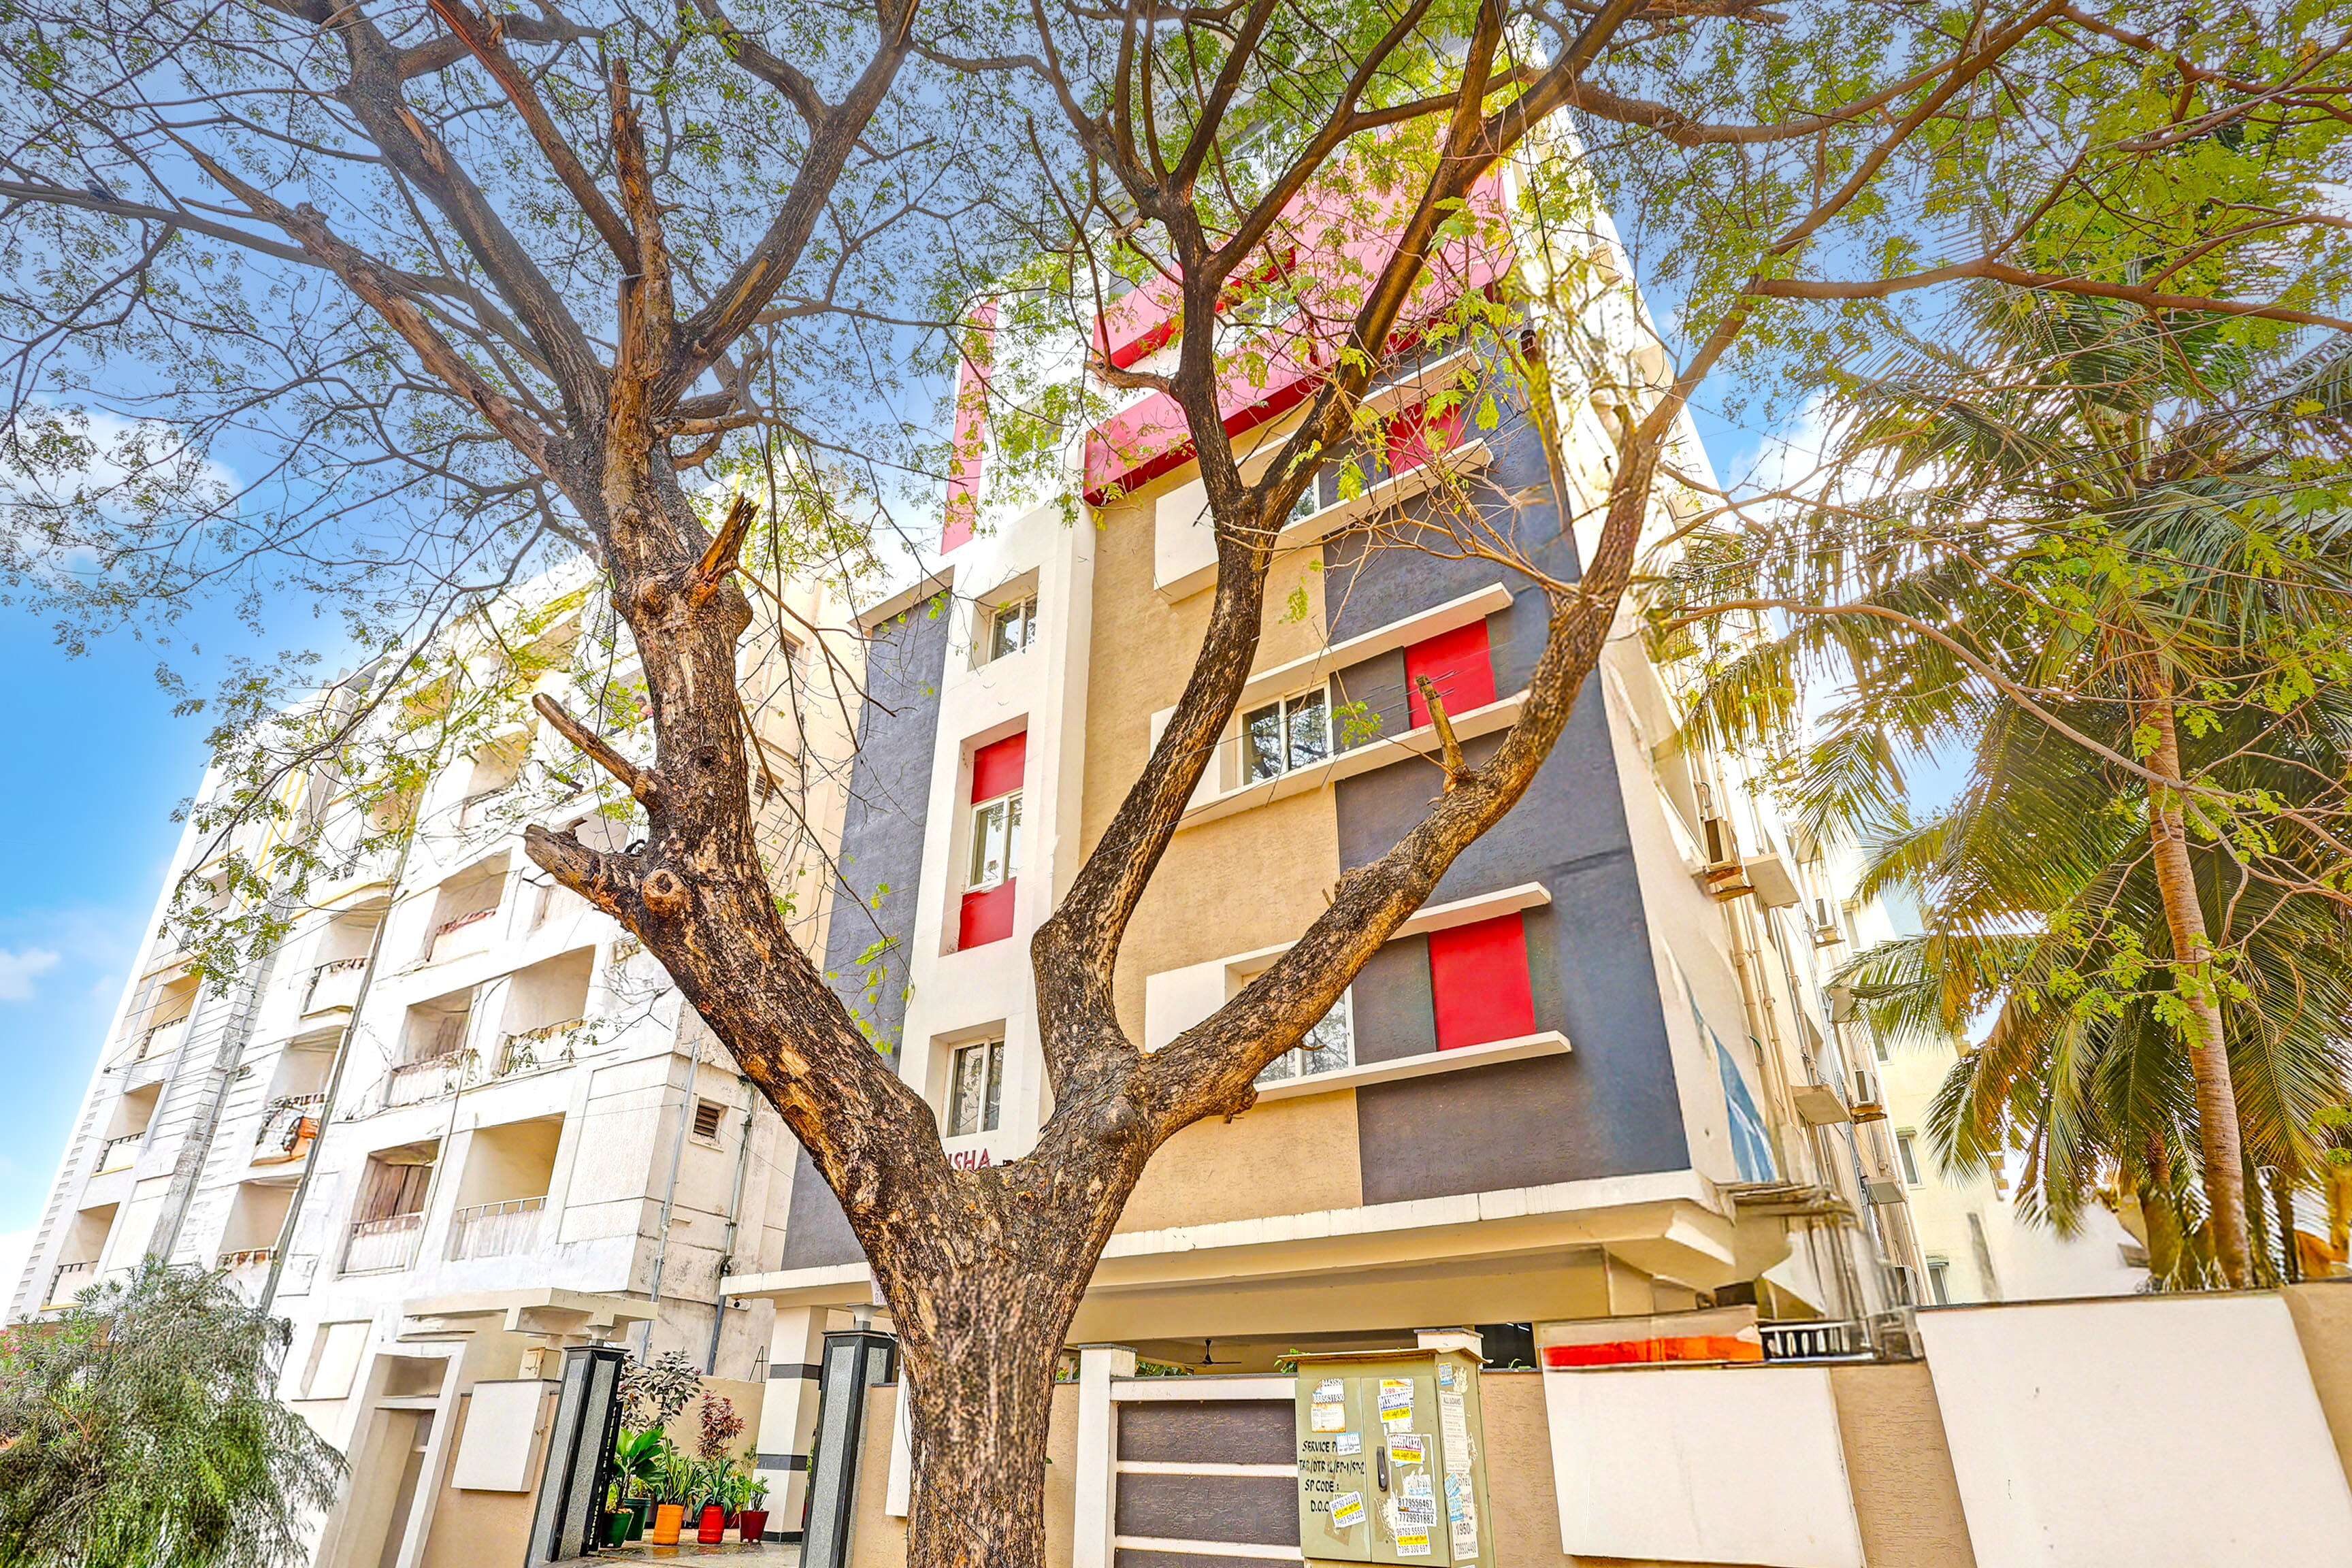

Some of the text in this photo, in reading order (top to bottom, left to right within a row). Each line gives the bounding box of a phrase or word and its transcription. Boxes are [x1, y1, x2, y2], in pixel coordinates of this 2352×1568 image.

[1302, 1441, 1330, 1452] SERVICE
[1305, 1479, 1314, 1491] SP
[1316, 1480, 1334, 1492] CODE
[1398, 1497, 1433, 1509] 8179556467
[1396, 1526, 1426, 1536] 96762 55553
